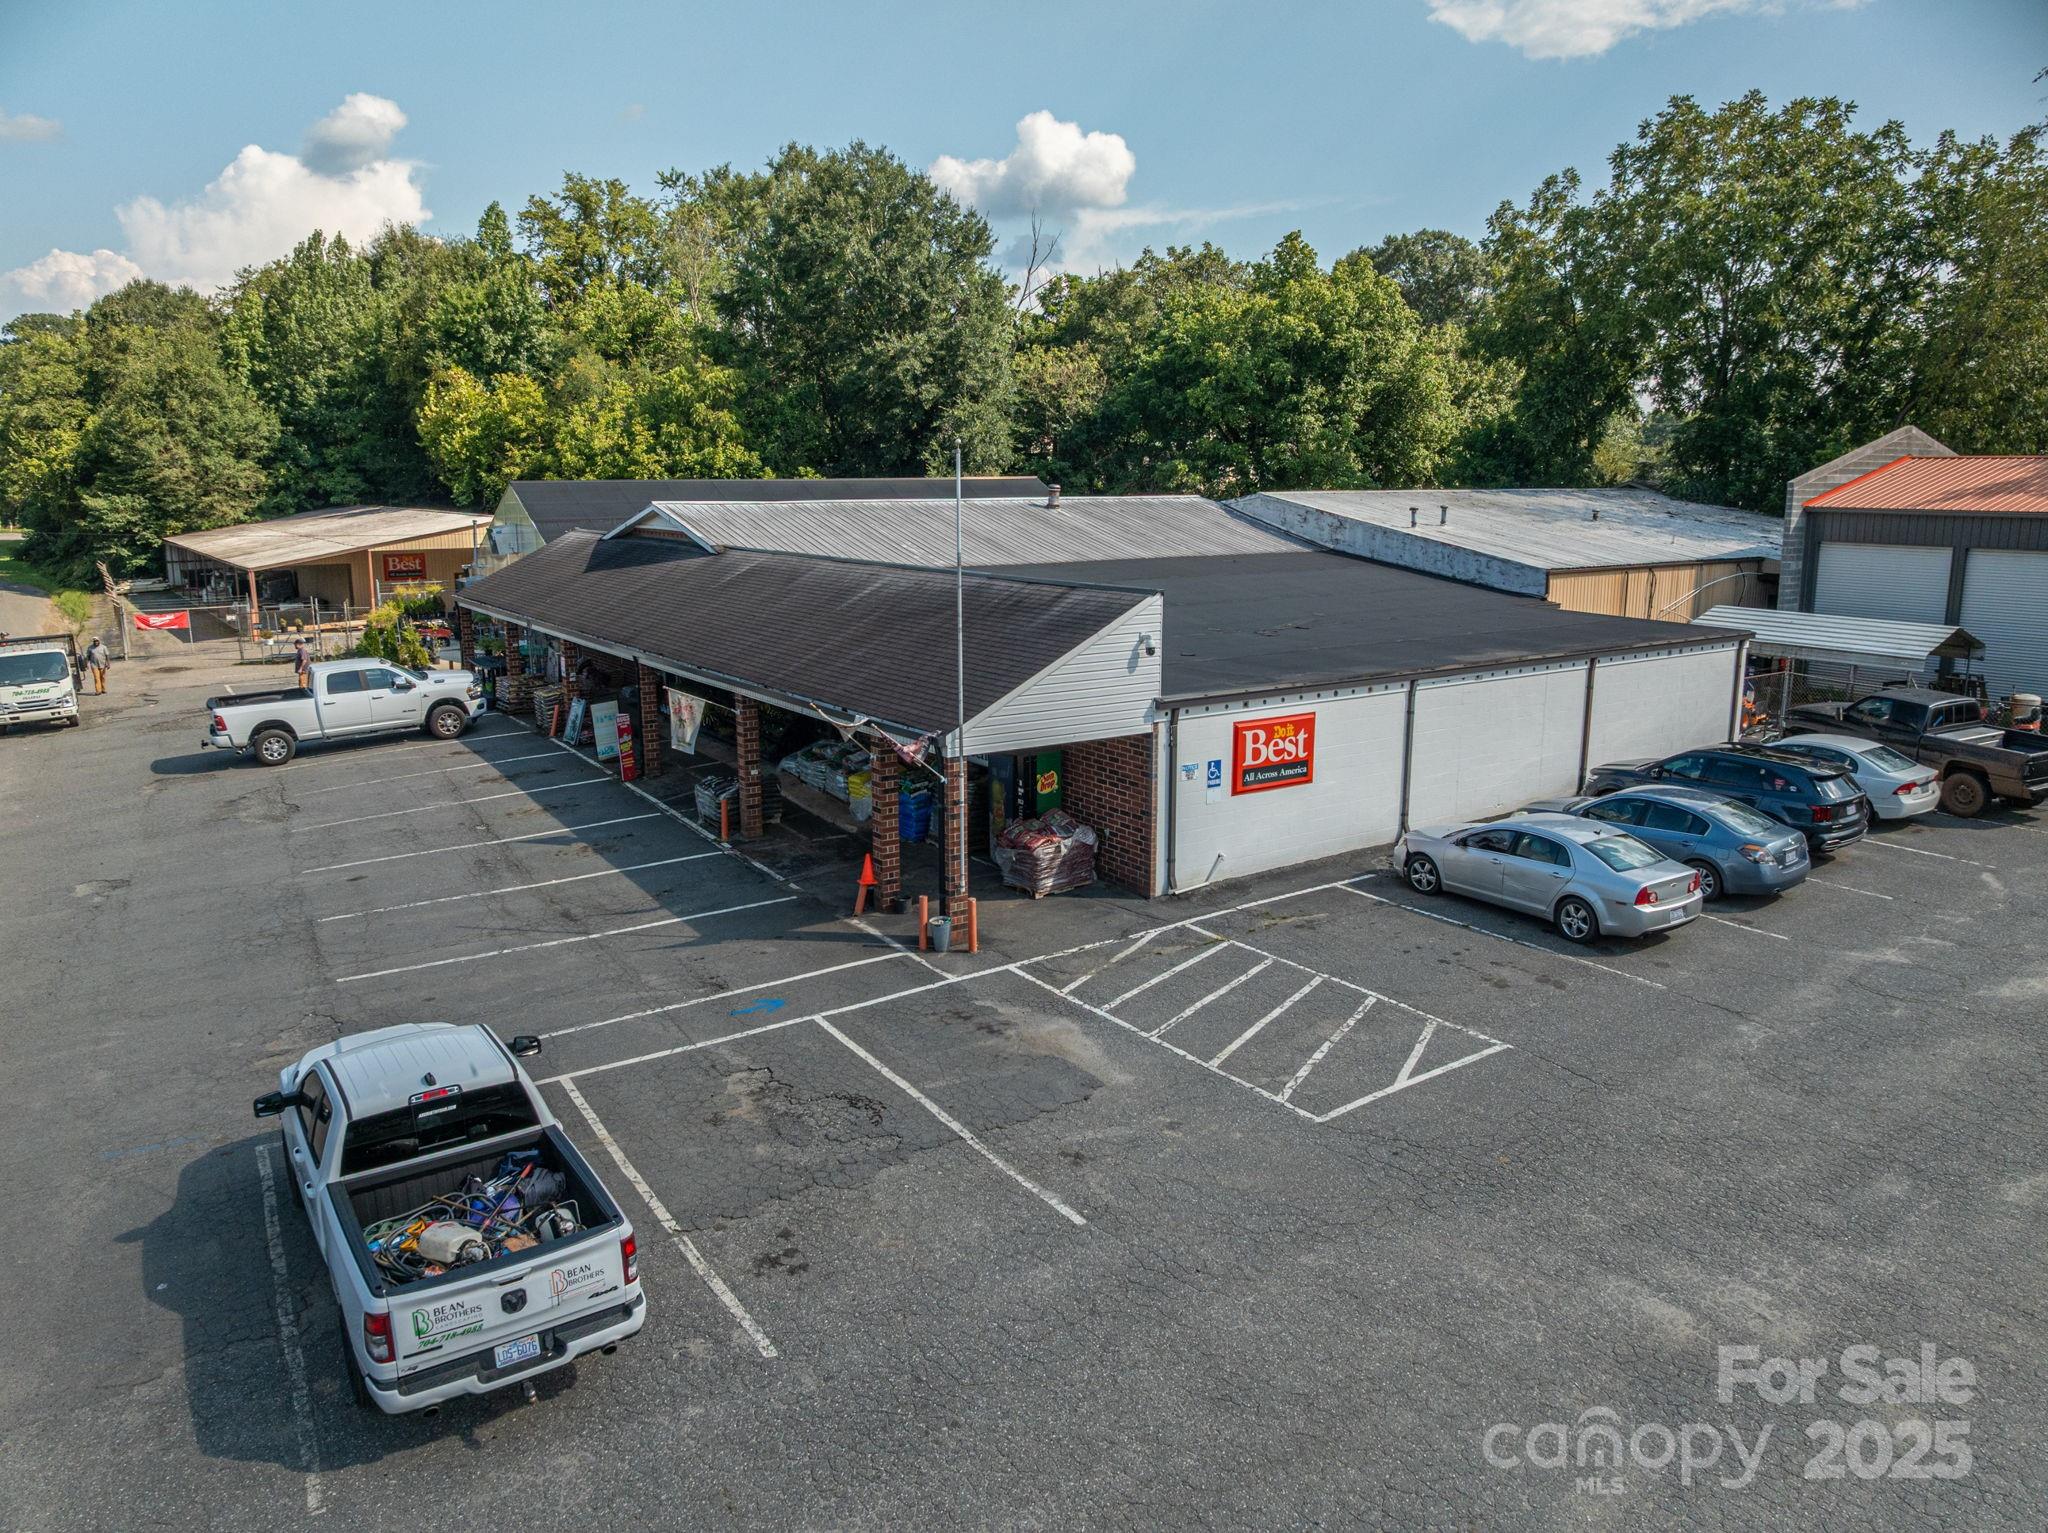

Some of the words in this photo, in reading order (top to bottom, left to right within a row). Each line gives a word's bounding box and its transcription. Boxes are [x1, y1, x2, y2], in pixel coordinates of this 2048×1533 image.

[388, 557, 422, 571] Best
[1274, 726, 1287, 739] Do
[1286, 723, 1295, 736] it
[1242, 728, 1308, 766] Best
[1244, 773, 1255, 782] All
[1256, 771, 1278, 780] Across
[1280, 765, 1307, 776] America
[567, 1264, 591, 1278] BEAN
[568, 1268, 605, 1286] BROTHERS
[433, 1301, 465, 1317] BEAN
[434, 1305, 483, 1324] BROTHERS
